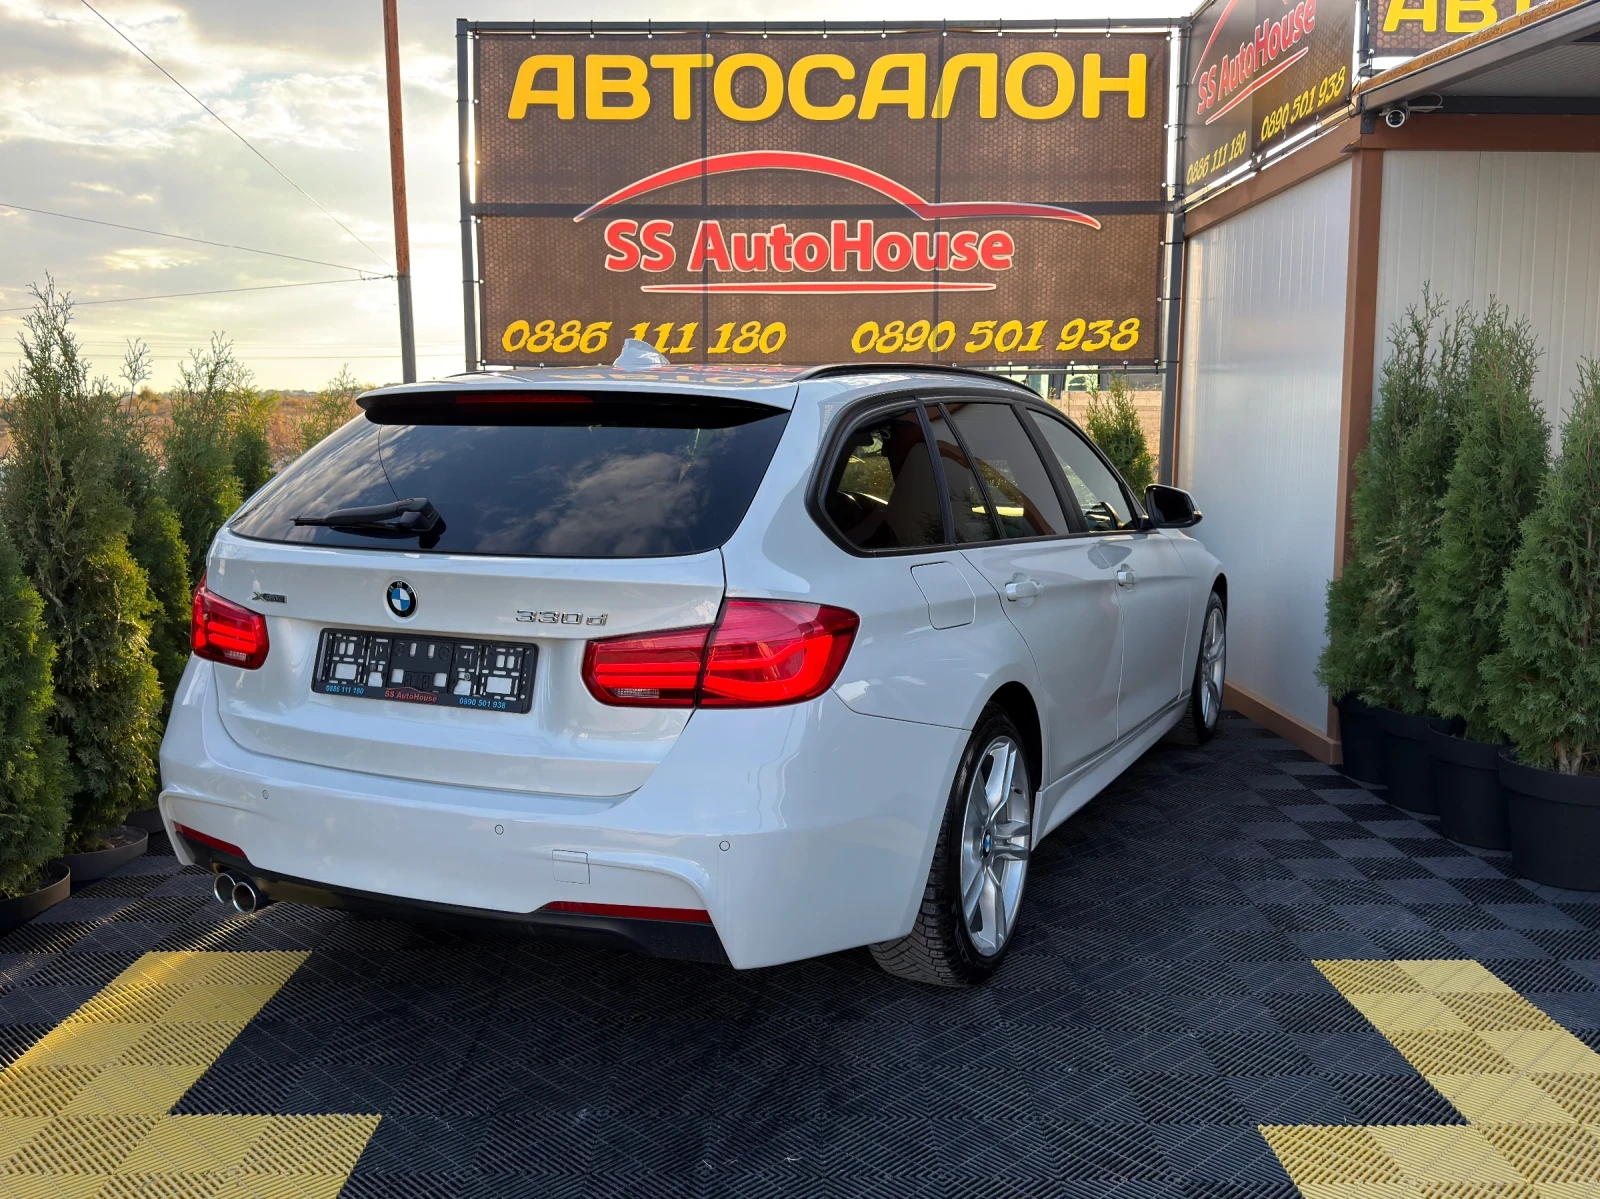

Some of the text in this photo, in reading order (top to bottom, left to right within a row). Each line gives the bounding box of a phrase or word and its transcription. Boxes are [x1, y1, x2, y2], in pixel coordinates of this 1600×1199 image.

[1197, 0, 1316, 114] SS AutoHouse
[507, 53, 1147, 121] АВТОСАЛОН
[1261, 65, 1346, 142] 0890 501 938
[1186, 130, 1247, 185] 0886 111 180
[604, 219, 1015, 273] SS AutoHouse
[502, 319, 614, 354] 0886
[708, 320, 787, 354] 180
[851, 317, 1141, 354] 0890 501 938
[515, 609, 609, 626] 330d
[325, 684, 365, 695] 0886 111 180
[384, 690, 438, 703] SS AutoHouse
[459, 697, 507, 709] 0890 501 938
